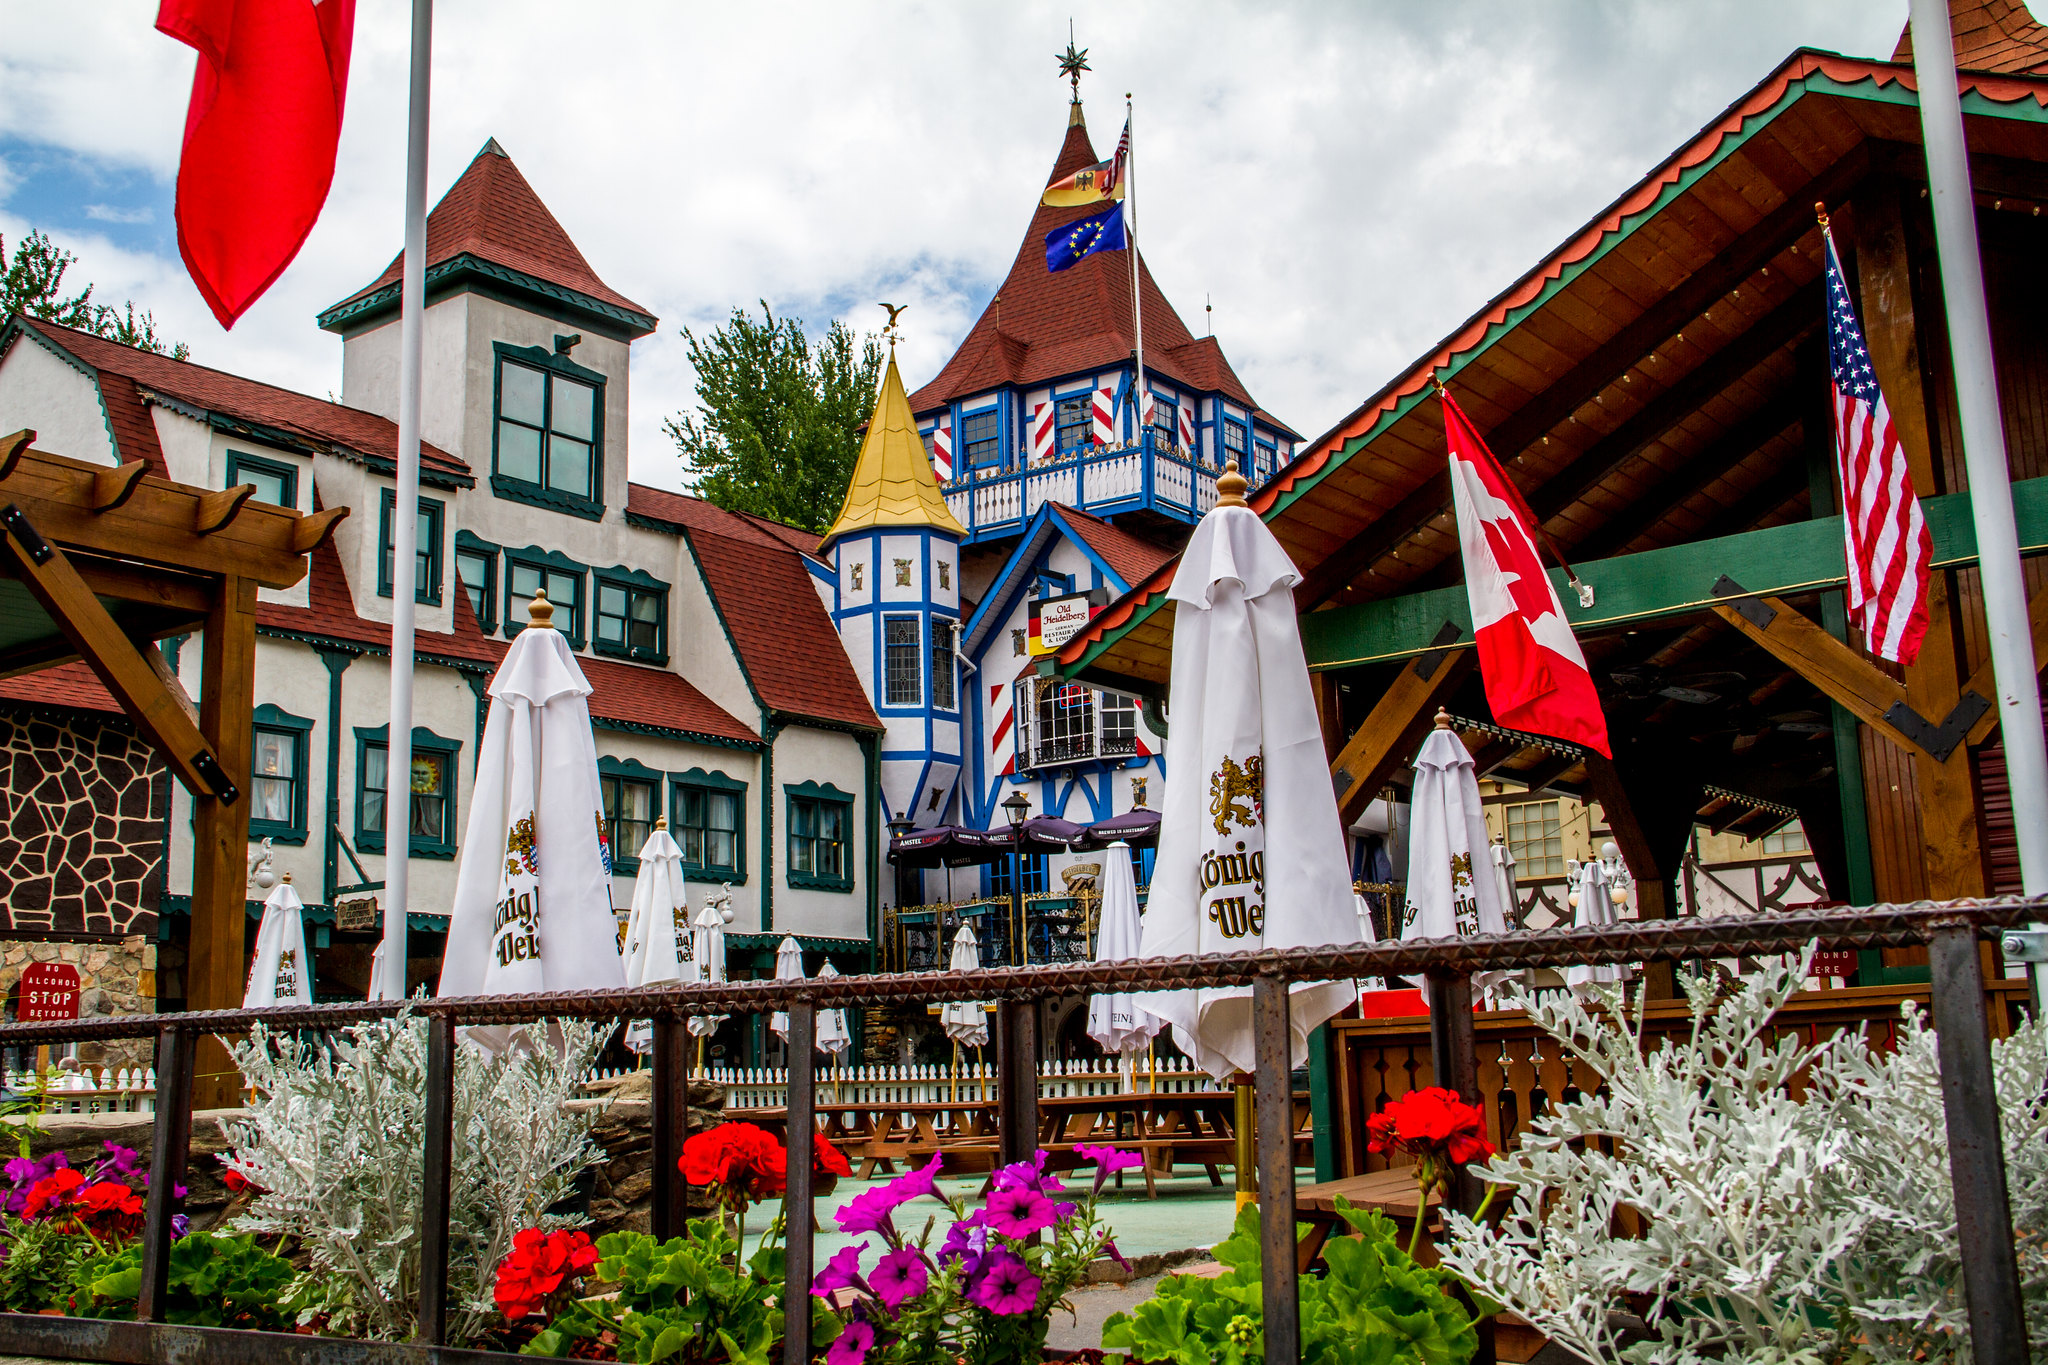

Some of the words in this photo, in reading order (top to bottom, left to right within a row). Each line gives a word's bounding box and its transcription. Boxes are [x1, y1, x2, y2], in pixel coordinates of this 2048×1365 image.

[1056, 604, 1071, 614] Old
[1043, 612, 1086, 625] Heidelberg
[900, 838, 922, 847] AMSTEL
[922, 836, 941, 844] LIGHT
[952, 857, 971, 865] AMSTEL
[494, 887, 531, 936] önig
[1794, 951, 1848, 960] BYOND
[1808, 966, 1840, 974] ERE
[28, 977, 76, 987] ALCOHOL
[30, 991, 71, 1006] STOP
[30, 1009, 70, 1018] BEYOND
